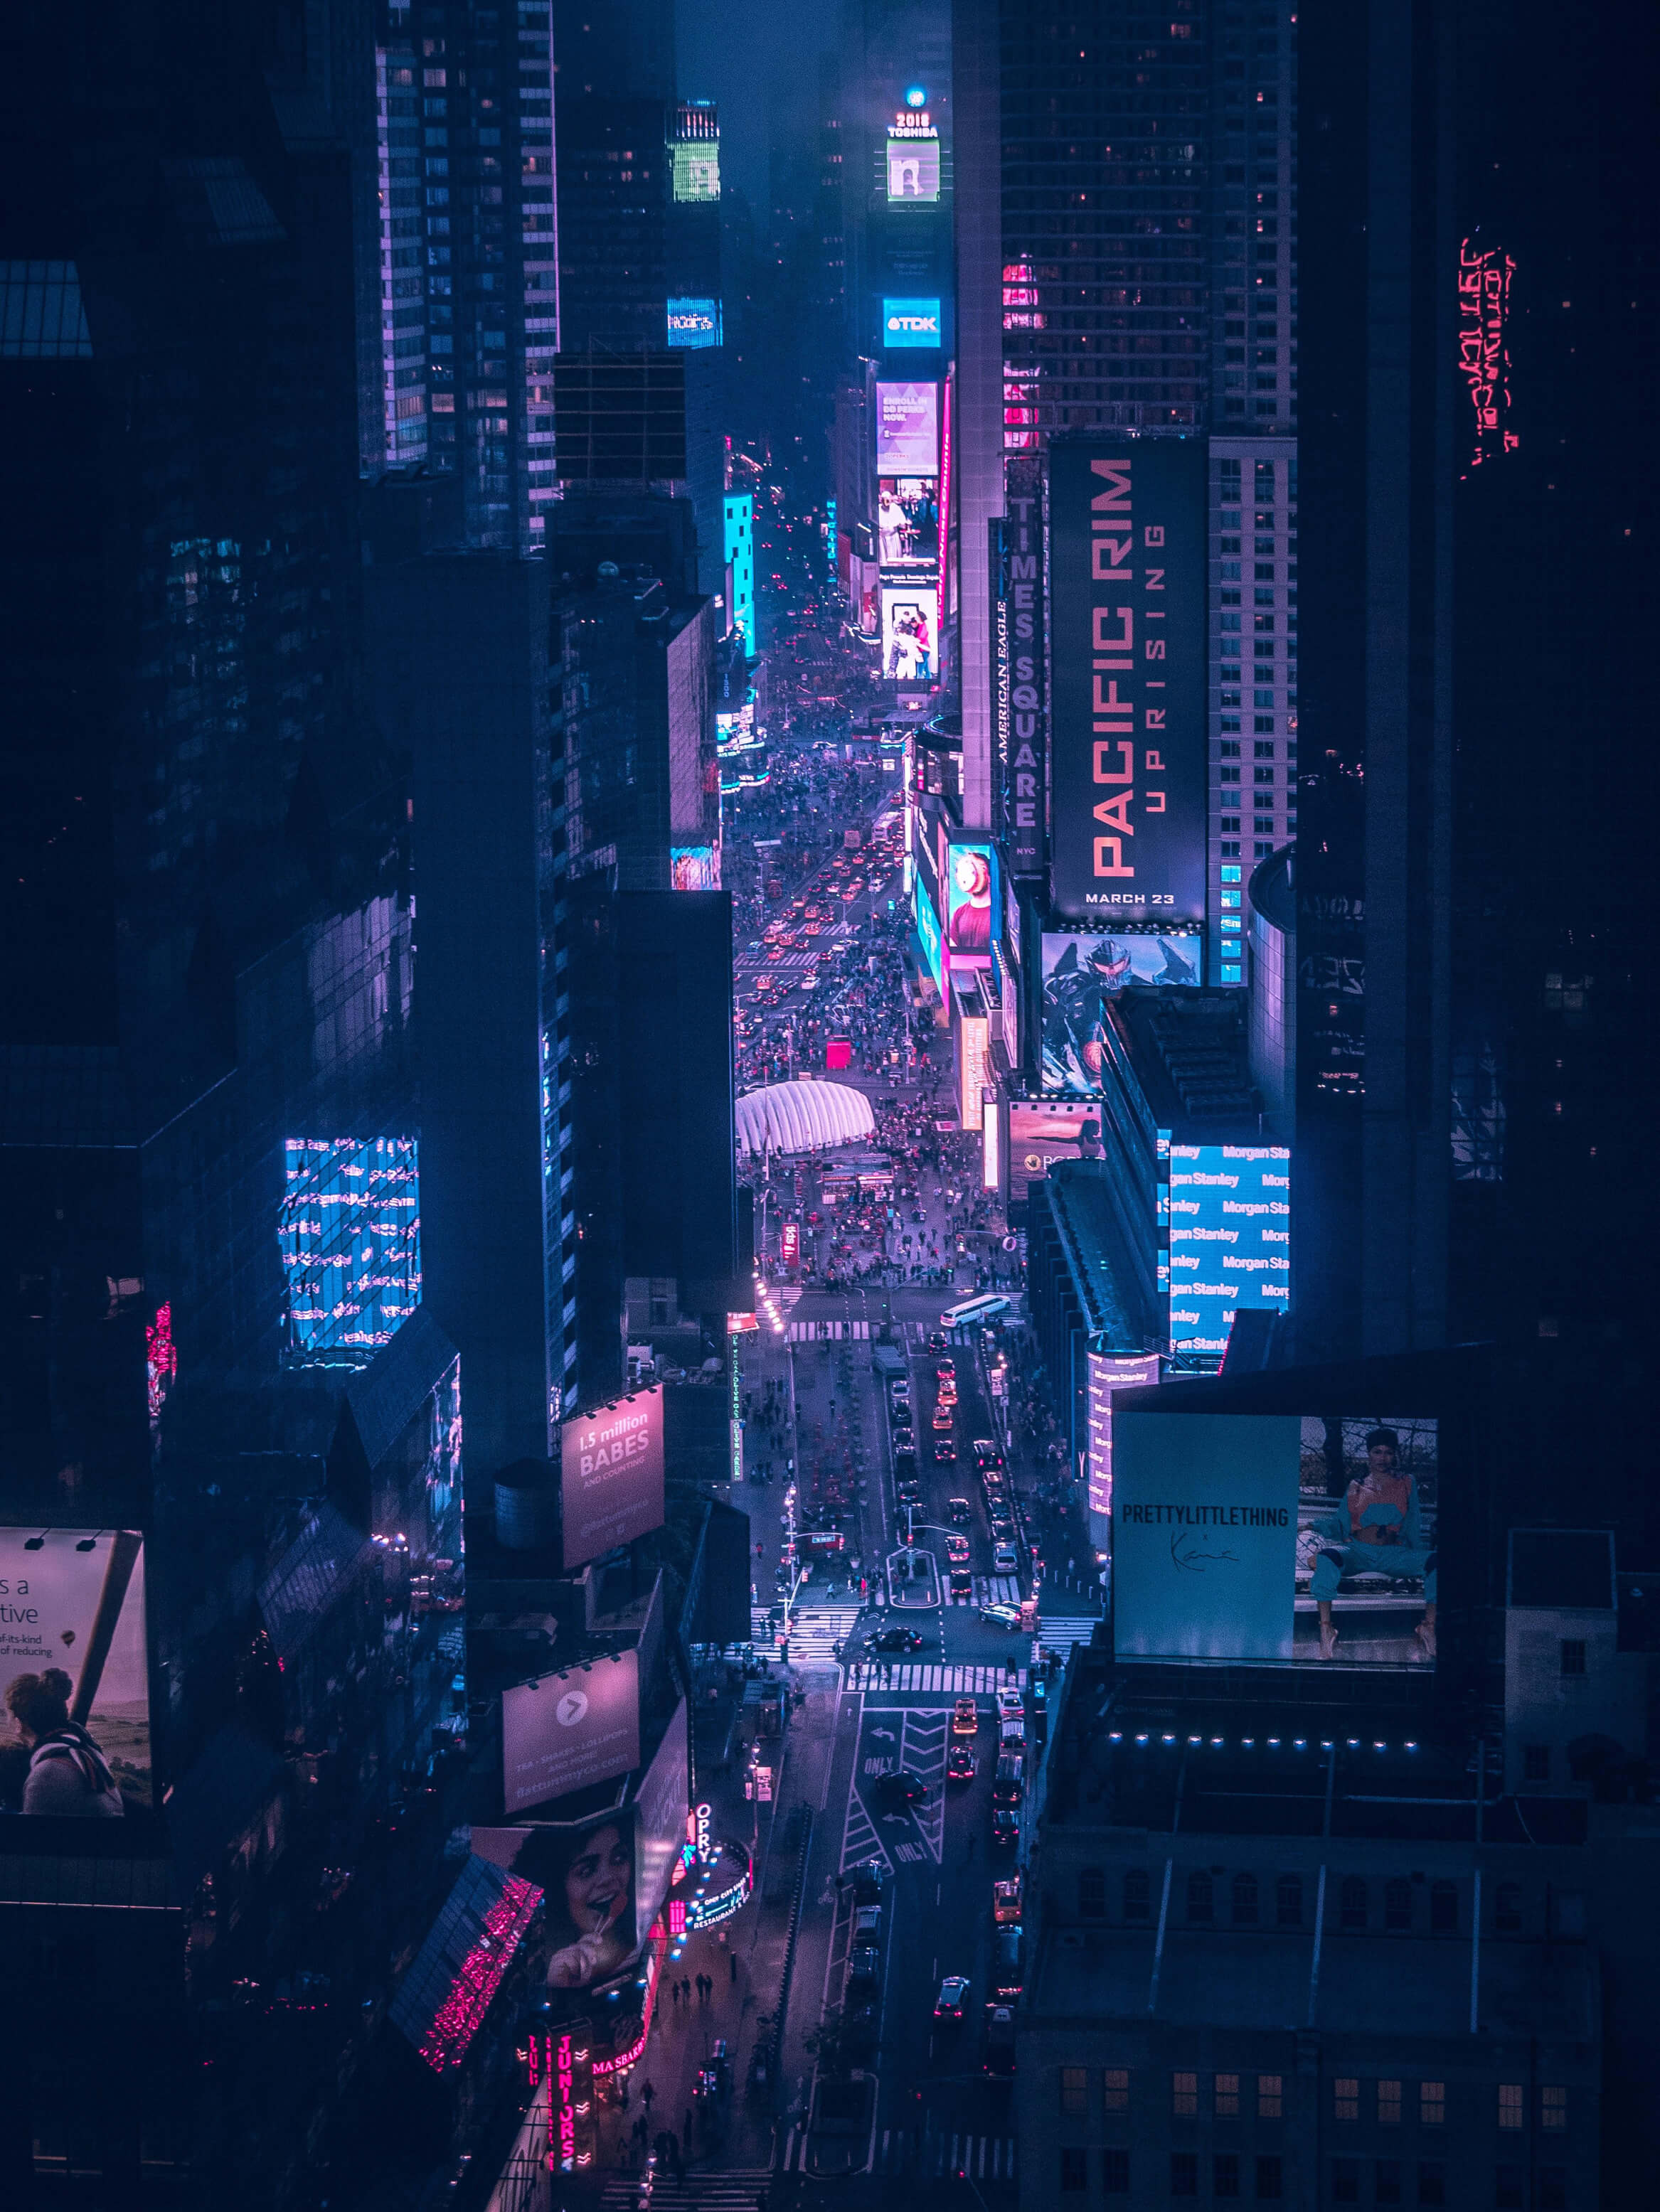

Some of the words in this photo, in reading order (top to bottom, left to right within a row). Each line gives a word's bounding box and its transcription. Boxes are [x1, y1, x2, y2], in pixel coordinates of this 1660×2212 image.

[896, 114, 929, 127] 2018
[888, 127, 938, 137] TOSHIBA
[898, 317, 937, 331] TDK
[1090, 459, 1133, 580] RIM
[1010, 498, 1036, 638] TIMES
[997, 601, 1007, 659] EAGLE
[1145, 525, 1166, 813] UPRISING
[998, 666, 1009, 764] AMERICAN
[1011, 656, 1039, 827] SQUARE
[1092, 606, 1135, 877] PACIFIC
[1086, 894, 1145, 904] MARCH
[1151, 894, 1174, 904] 23
[1223, 1145, 1269, 1161] Morgan
[1193, 1172, 1239, 1188] Stanley
[1223, 1200, 1269, 1216] Morgan
[1193, 1227, 1239, 1244] Stanley
[1223, 1256, 1269, 1271] Morgan
[1193, 1282, 1239, 1298] Stanley
[1095, 1370, 1120, 1382] Morgan
[1119, 1372, 1148, 1382] Stanley
[580, 1431, 597, 1452] 1.5
[600, 1413, 649, 1443] million
[580, 1429, 650, 1478] BABES
[584, 1475, 602, 1489] AND
[603, 1455, 645, 1480] COUNTING
[1122, 1504, 1289, 1527] PRETTYLITTLETHING
[17, 1579, 29, 1595] a
[0, 1604, 39, 1624] tive
[13, 1646, 53, 1659] reducing
[864, 1757, 893, 1774] ONLY
[696, 1803, 712, 1863] OPRY
[894, 1842, 927, 1862] ONLY
[693, 1906, 736, 1929] RESTAURANT
